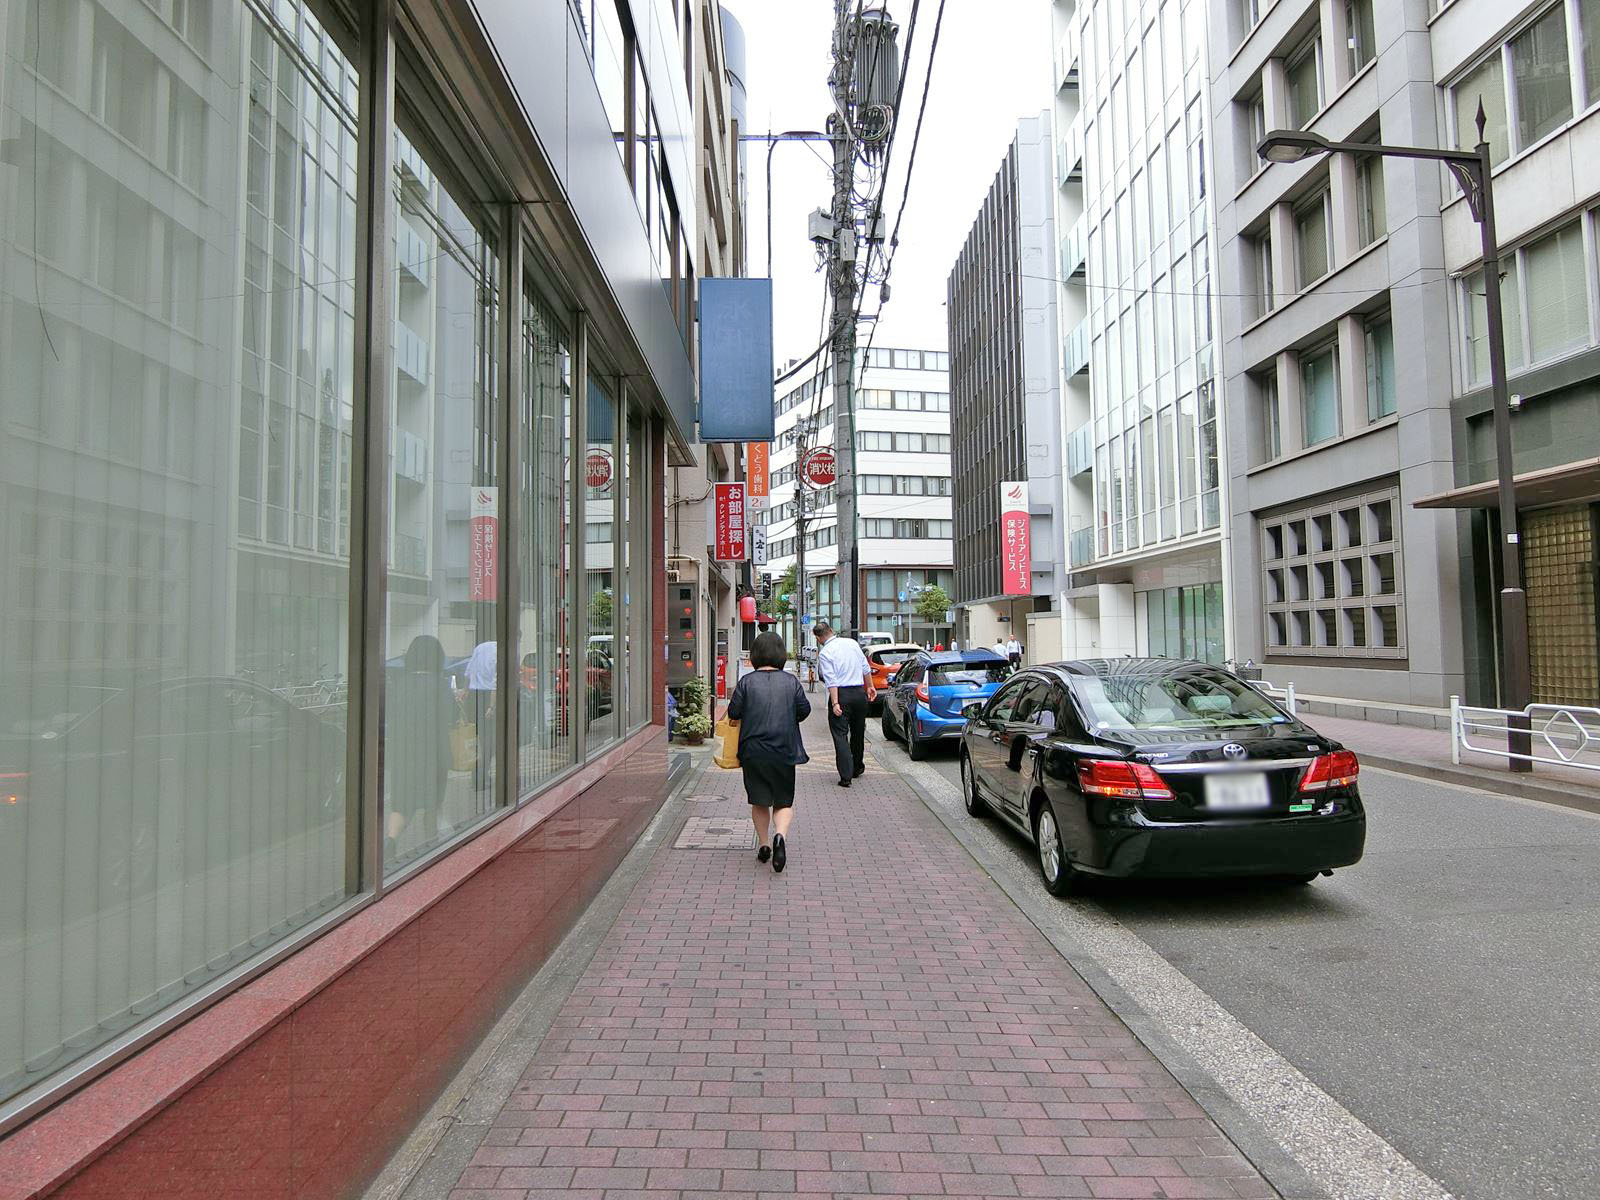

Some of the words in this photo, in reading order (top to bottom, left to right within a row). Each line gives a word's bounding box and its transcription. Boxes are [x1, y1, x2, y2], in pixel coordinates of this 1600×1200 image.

[753, 443, 764, 494] くどう歯科
[810, 462, 836, 475] 消火栓
[728, 487, 743, 558] お部屋探し
[751, 498, 766, 508] 2F
[1007, 519, 1017, 571] 保険サービス
[1017, 519, 1027, 589] ジェイアンドエス
